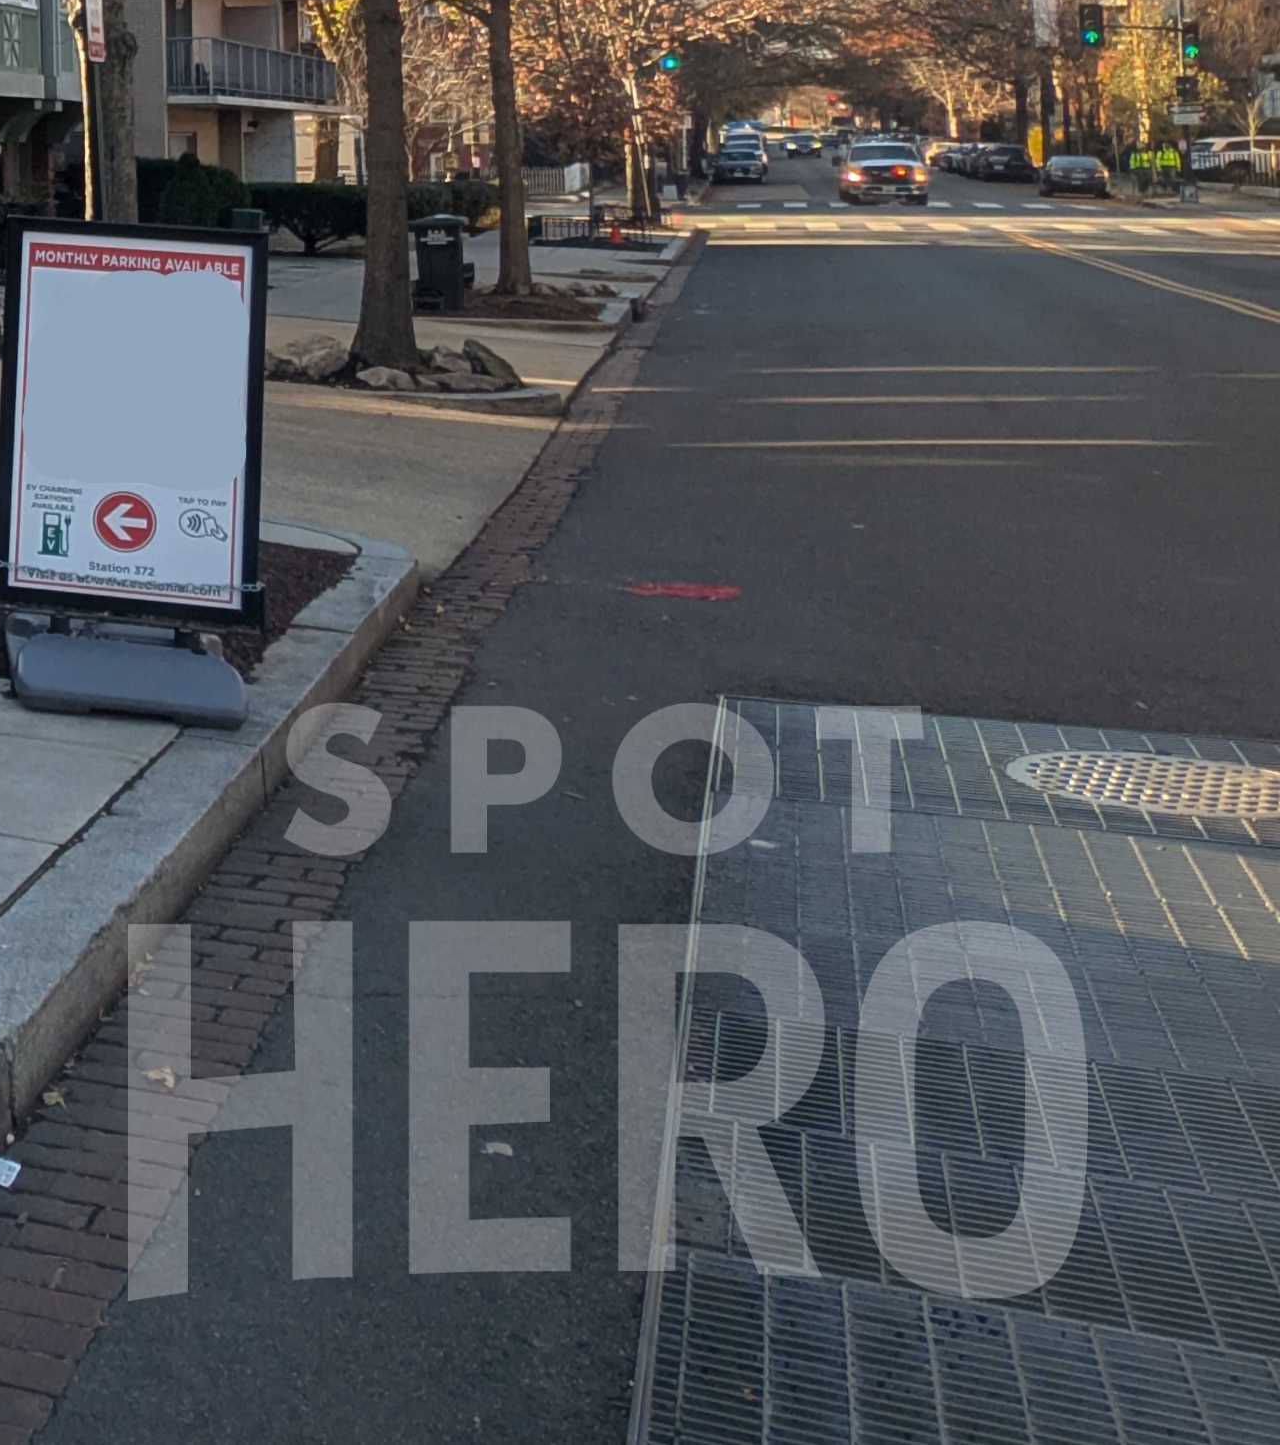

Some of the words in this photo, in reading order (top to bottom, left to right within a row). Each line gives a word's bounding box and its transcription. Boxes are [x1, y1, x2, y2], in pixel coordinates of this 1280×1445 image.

[35, 249, 98, 266] MONTHLY
[101, 256, 161, 271] PARKING
[164, 258, 240, 276] AVAILABLE
[26, 483, 38, 491] EV
[38, 484, 83, 495] CHARGING
[34, 493, 74, 503] STATIONS
[178, 496, 195, 505] TAP
[196, 498, 209, 507] TO
[210, 499, 228, 507] PAY
[31, 501, 76, 512] AVAILABLE
[88, 561, 130, 575] Station
[133, 565, 155, 577] 372
